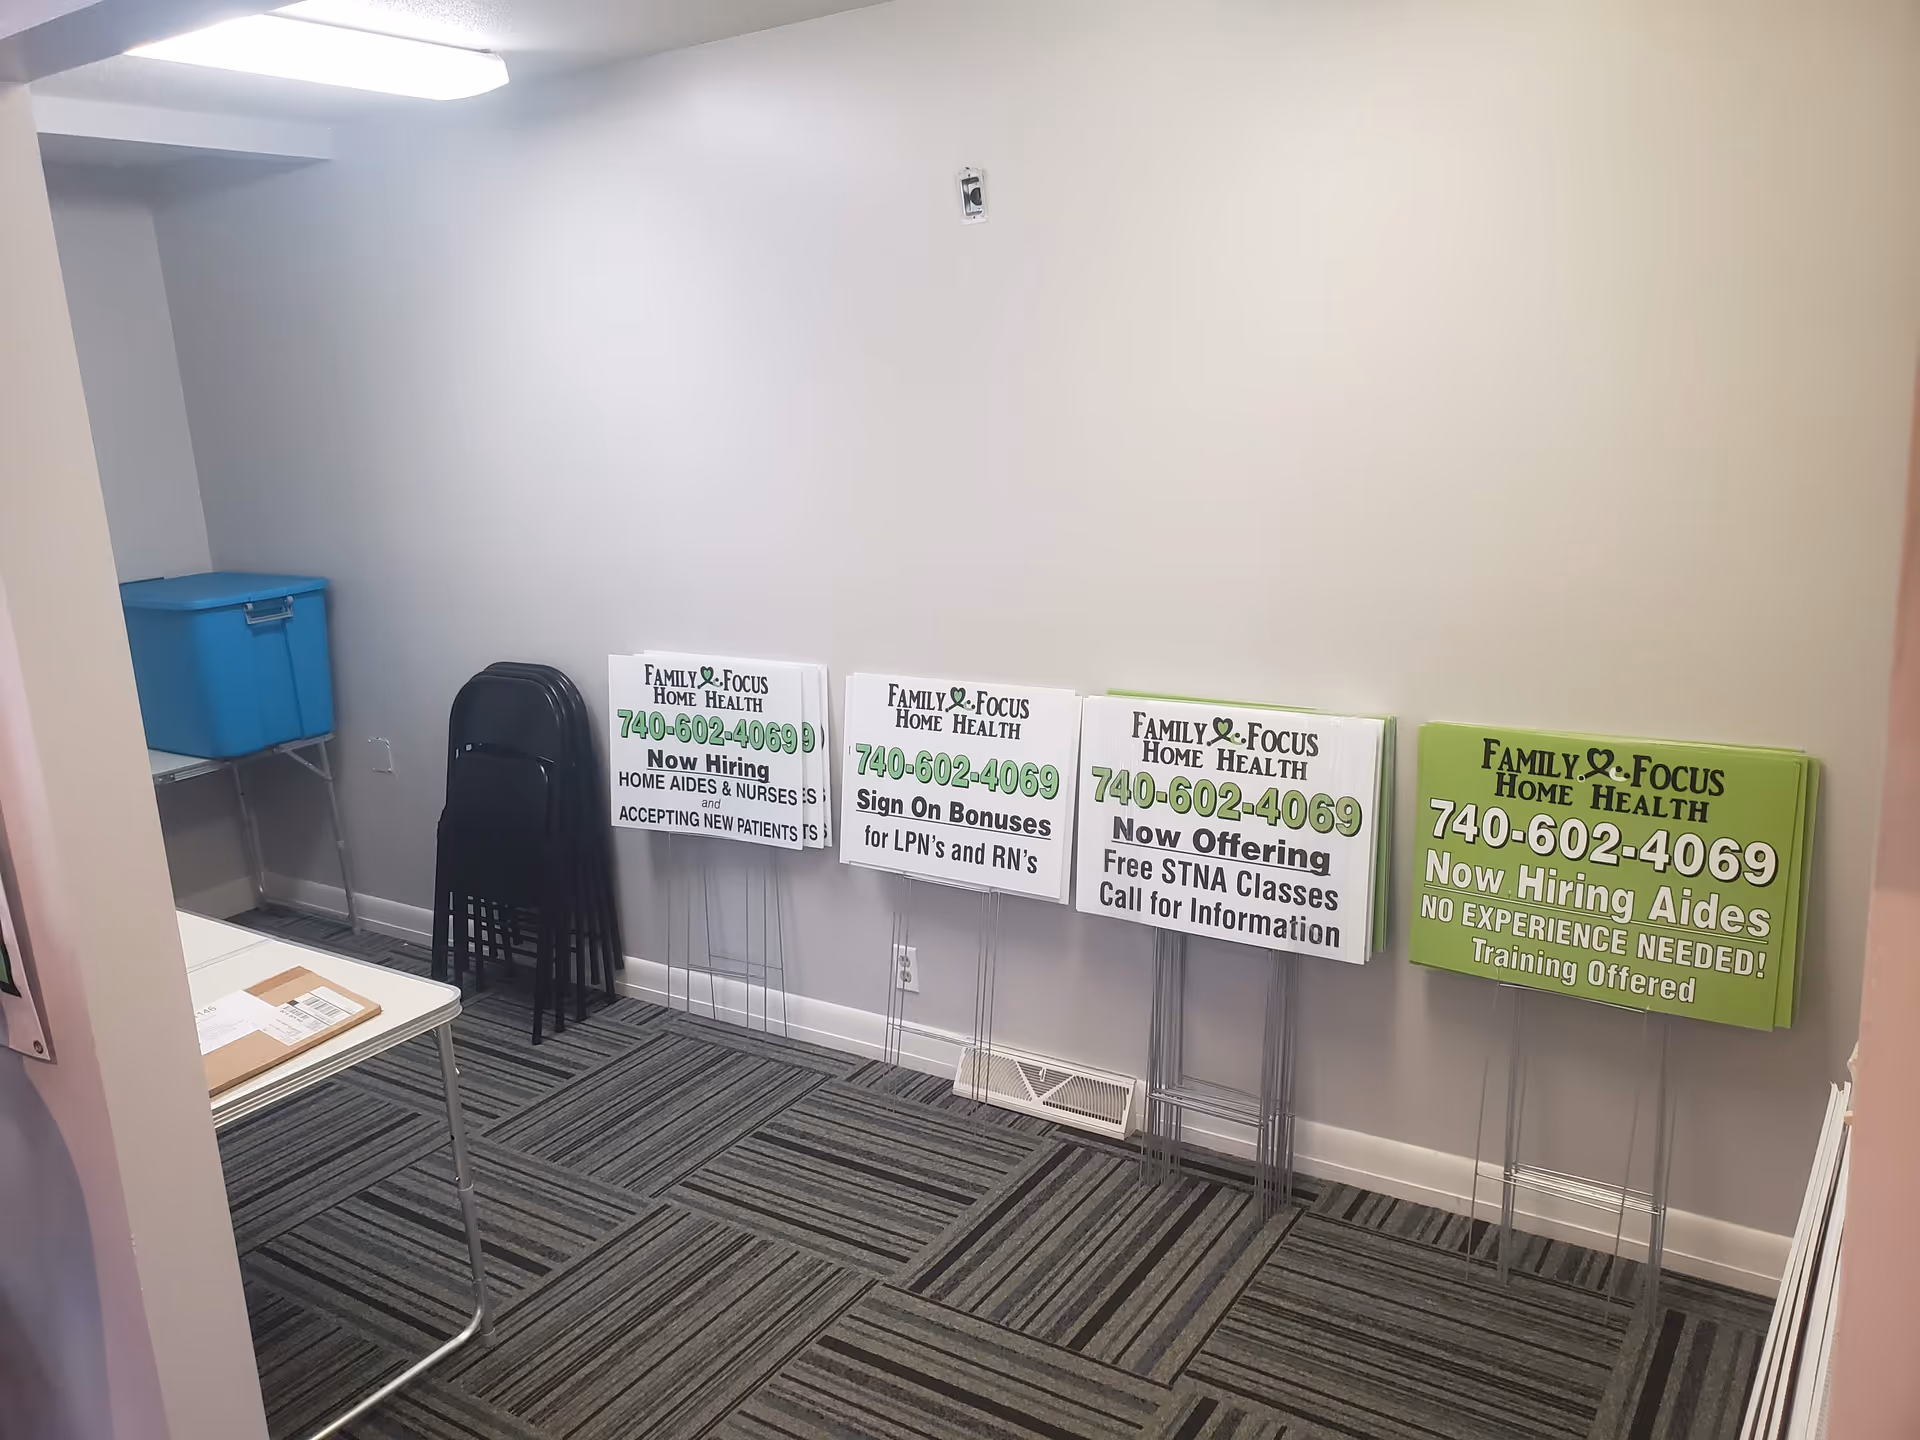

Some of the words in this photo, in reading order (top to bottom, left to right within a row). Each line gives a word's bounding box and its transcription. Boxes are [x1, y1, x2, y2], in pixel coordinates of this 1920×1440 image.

[644, 664, 697, 688] FAMILY
[723, 670, 768, 694] FOCUS
[654, 687, 696, 706] HOME
[705, 691, 763, 712] HEALTH
[888, 683, 946, 711] FAMILY
[975, 690, 1029, 719] FOCUS
[617, 710, 798, 754] 740-602-4069
[895, 709, 942, 732] HOME
[952, 714, 1021, 739] HEALTH
[1132, 711, 1208, 745] FAMILY
[1247, 722, 1318, 757] FOCUS
[648, 749, 697, 770] Now
[706, 754, 769, 783] Hiring
[856, 743, 1059, 799] 740-602-4069
[1142, 741, 1203, 768] HOME
[1216, 749, 1308, 780] HEALTH
[1481, 738, 1579, 780] FAMILY
[1630, 755, 1724, 796] FOCUS
[619, 772, 665, 789] HOME
[670, 776, 717, 794] AIDES
[722, 782, 731, 796] &
[737, 783, 797, 805] NURSES
[702, 799, 721, 809] and
[857, 789, 903, 816] Sign
[912, 797, 941, 819] On
[950, 802, 1051, 836] Bonuses
[1092, 766, 1362, 837] 740-602-4069
[1495, 771, 1573, 805] HOME
[1590, 785, 1709, 823] HEALTH
[619, 806, 699, 826] ACCEPTING
[704, 813, 733, 830] NEW
[737, 819, 798, 842] PATIENTS
[1113, 816, 1181, 848] Now
[1193, 828, 1330, 876] Offering
[1430, 798, 1778, 886] 740-602-4069
[865, 825, 888, 848] for
[895, 829, 944, 858] LPN's
[951, 843, 985, 864] and
[993, 845, 1037, 874] RN's
[1104, 849, 1152, 880] Free
[1162, 858, 1227, 892] STNA
[1237, 870, 1338, 911] Classes
[1426, 849, 1505, 894] Now
[1518, 865, 1634, 923] Hiring
[1649, 886, 1771, 937] Aides
[1100, 881, 1141, 911] Call
[1151, 891, 1182, 918] for
[1191, 897, 1340, 947] Information
[1421, 895, 1454, 922] NO
[1462, 902, 1627, 955] EXPERIENCE
[1637, 933, 1766, 978] NEEDED!
[1472, 937, 1577, 985] Training
[1587, 960, 1696, 1003] Offered
